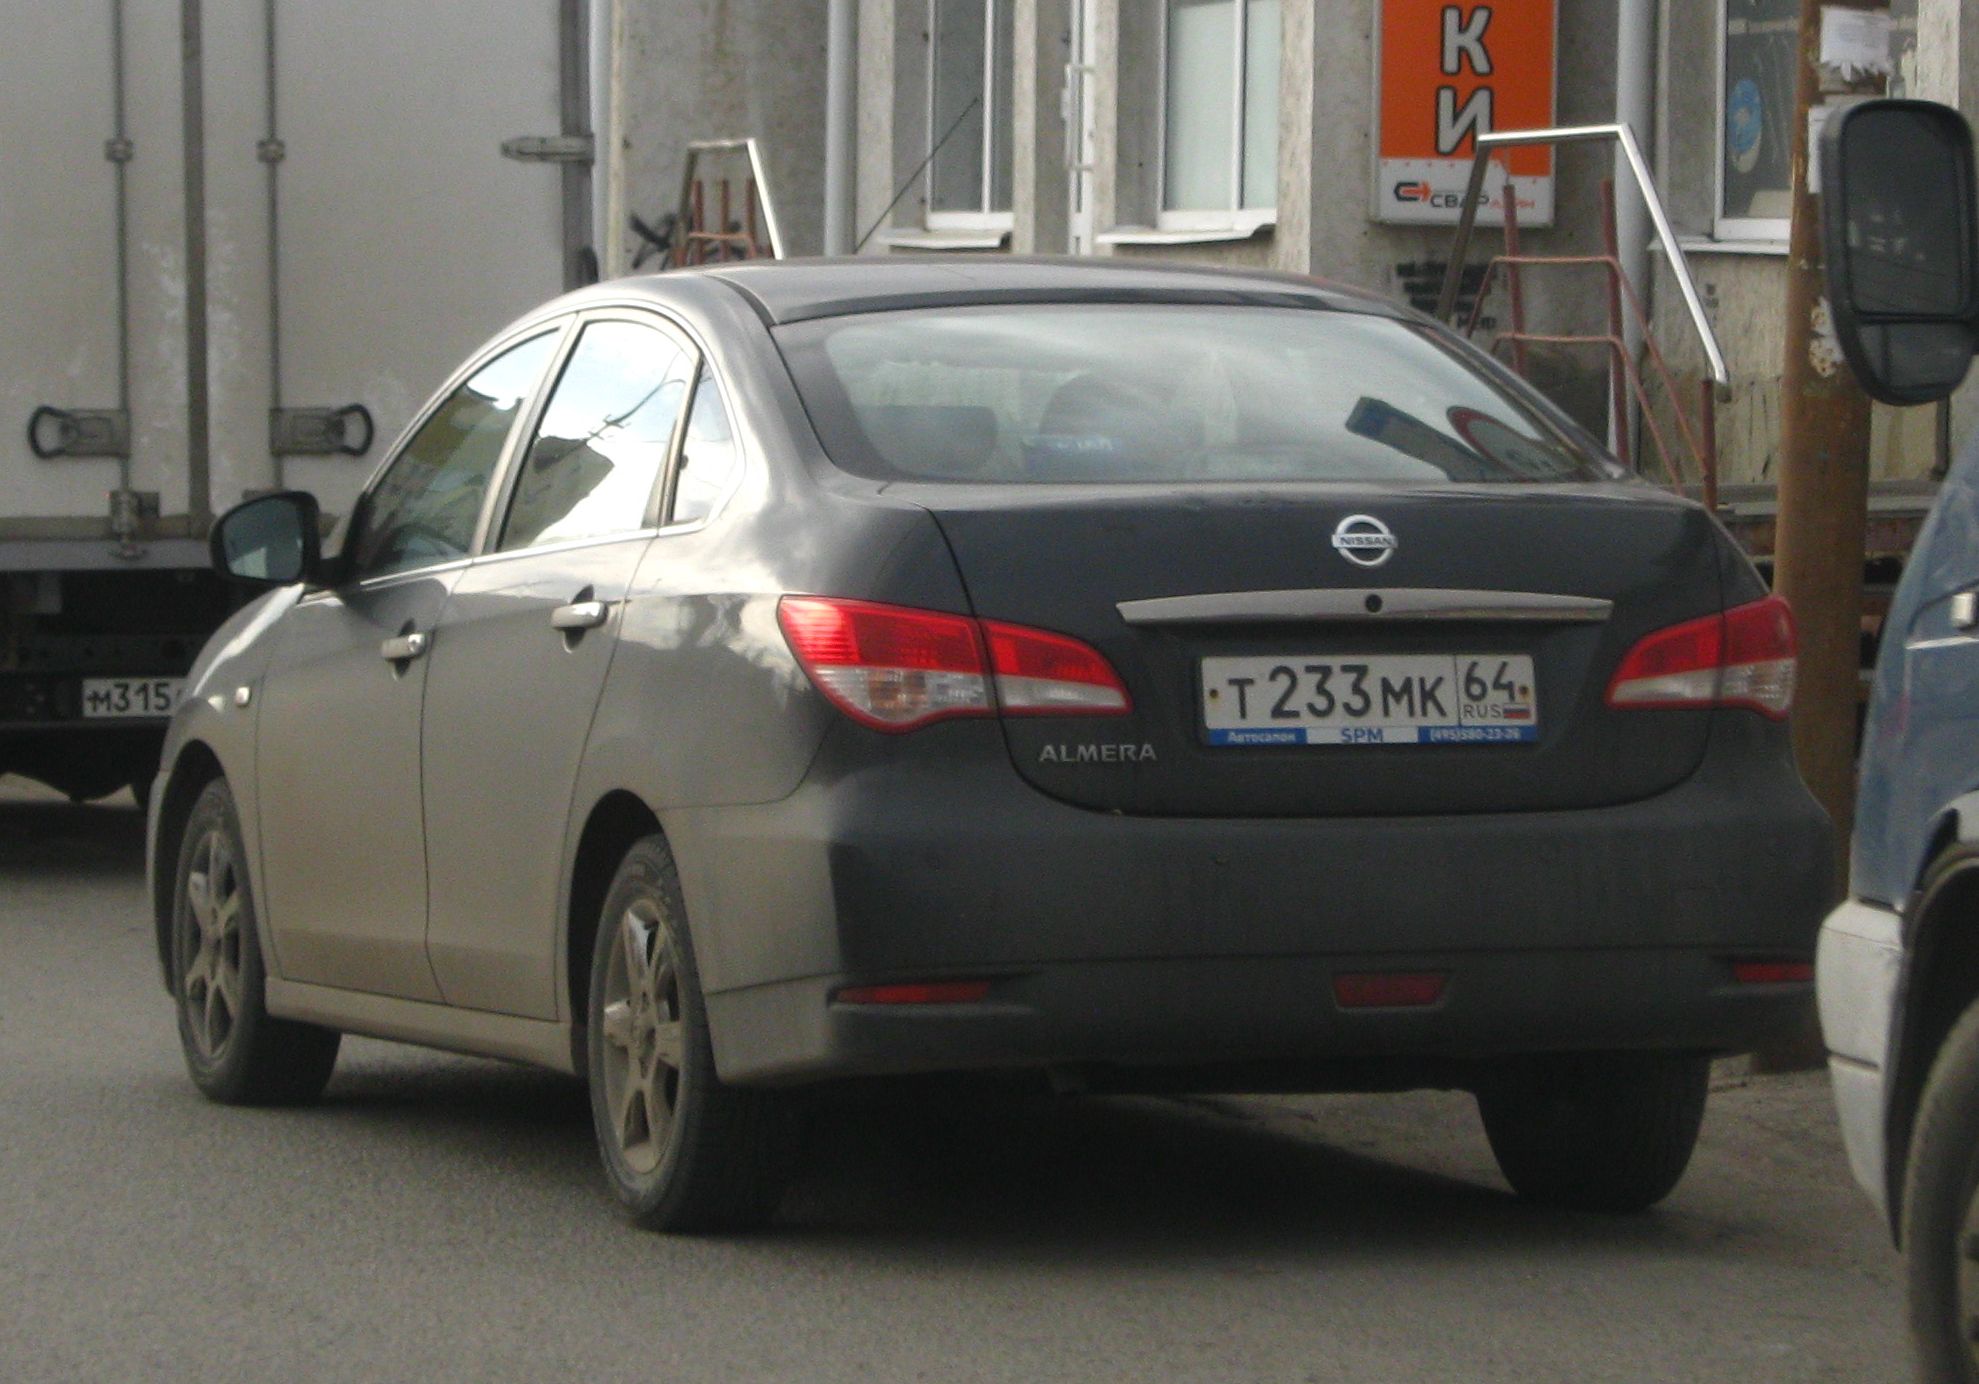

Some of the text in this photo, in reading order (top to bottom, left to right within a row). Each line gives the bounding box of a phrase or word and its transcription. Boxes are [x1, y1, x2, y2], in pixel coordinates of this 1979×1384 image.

[1339, 535, 1393, 546] NISSAN
[86, 682, 183, 712] М315
[1228, 661, 1516, 720] Т233МК 64
[1463, 703, 1503, 720] RUS
[1340, 727, 1384, 743] SPM
[1038, 743, 1158, 762] ALMERA
